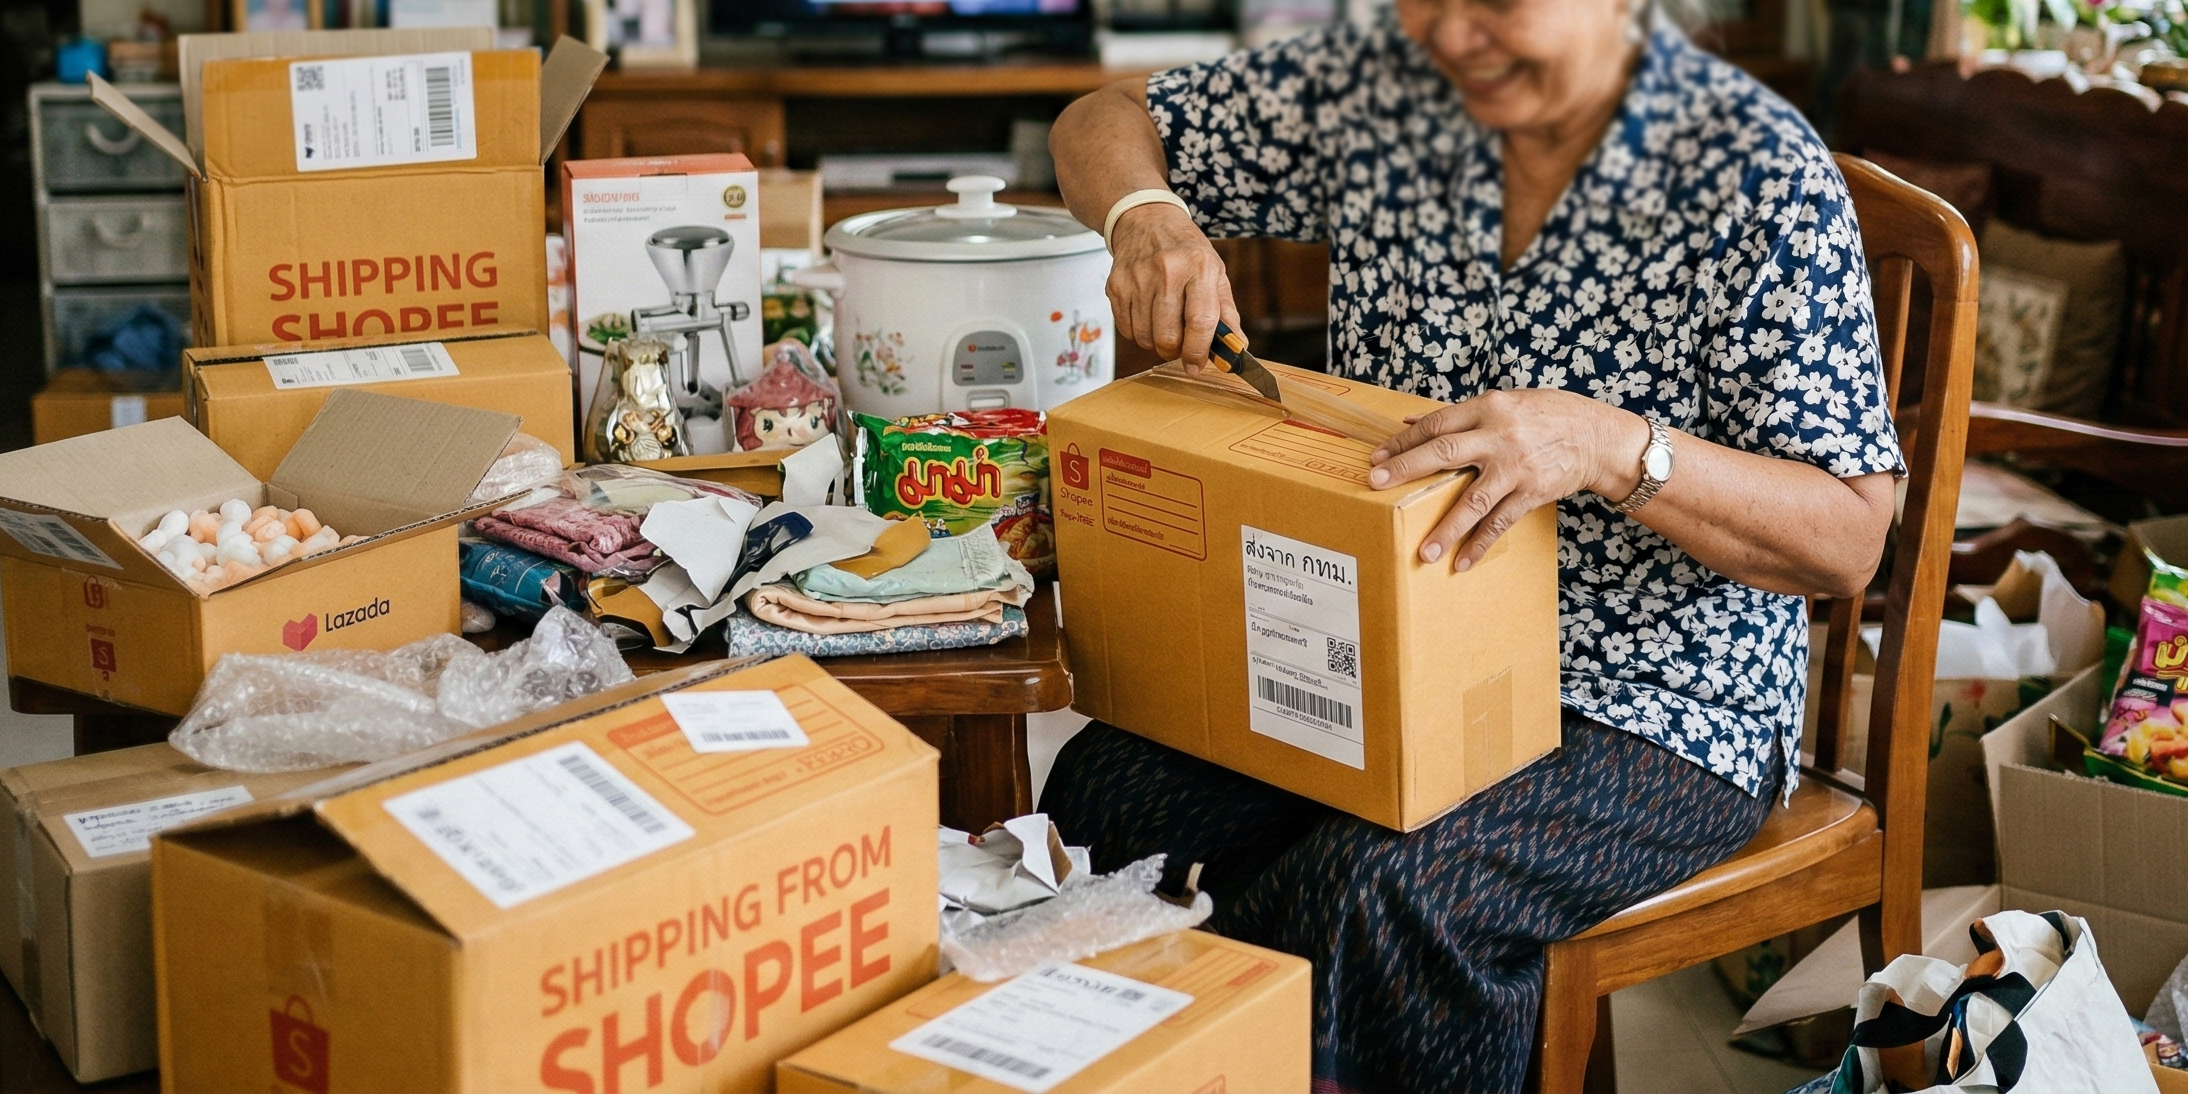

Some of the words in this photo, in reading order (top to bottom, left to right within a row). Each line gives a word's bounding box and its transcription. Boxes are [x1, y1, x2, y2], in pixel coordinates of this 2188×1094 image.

[268, 251, 498, 301] SHIPPING
[1245, 532, 1295, 569] ส่งจาก
[1302, 555, 1352, 586] กทม.
[325, 597, 390, 633] Lazada
[539, 883, 762, 1018] SHIPPING
[776, 825, 892, 916] FROM
[539, 887, 892, 1094] SHOPEE
